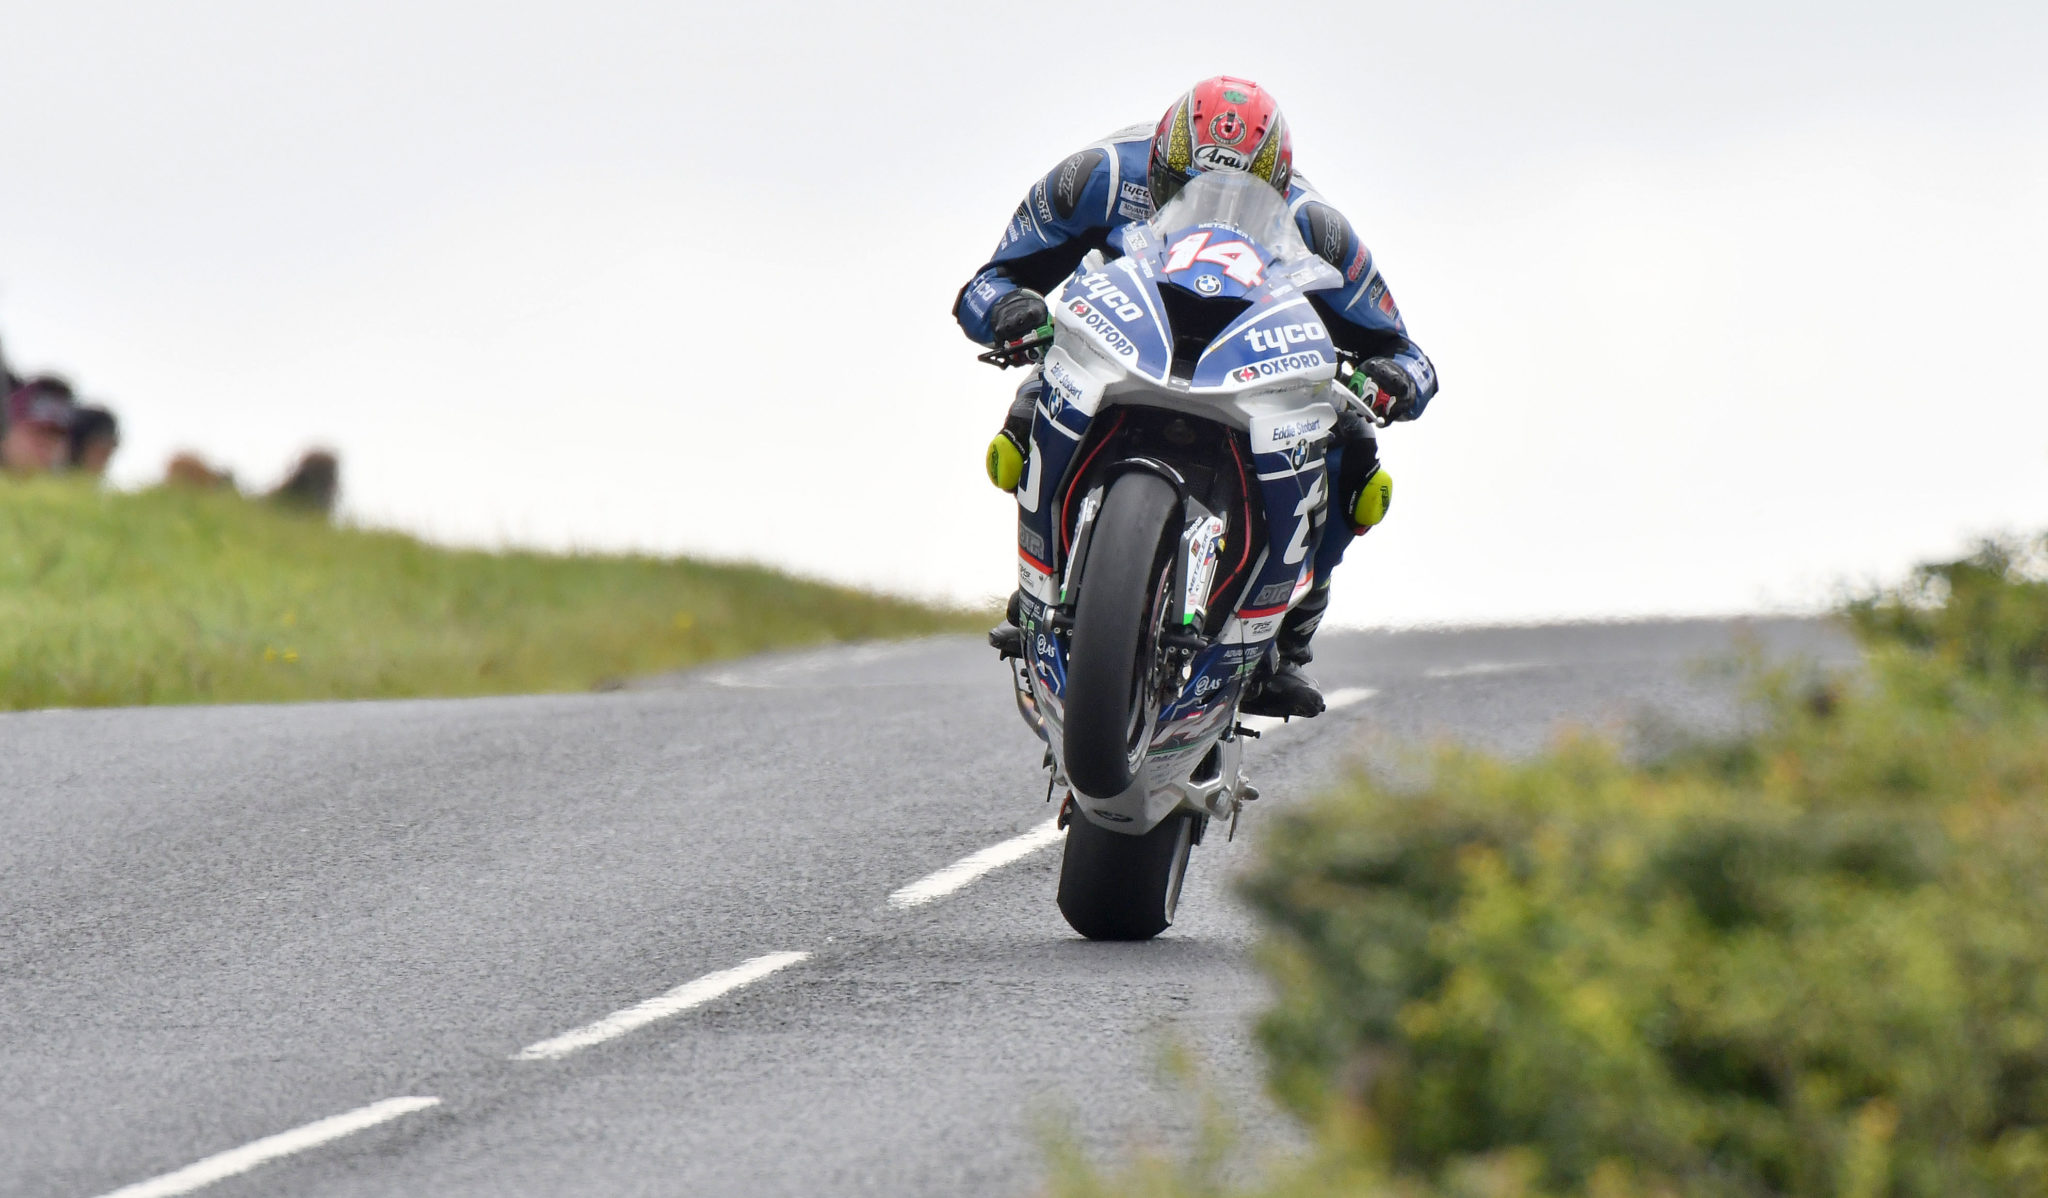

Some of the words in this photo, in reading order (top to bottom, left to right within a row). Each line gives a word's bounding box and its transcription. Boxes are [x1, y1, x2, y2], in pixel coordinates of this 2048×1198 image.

[1162, 231, 1265, 288] 14
[1081, 272, 1145, 322] tyco
[1085, 313, 1134, 357] OXFORD
[1244, 322, 1326, 354] tyco
[1260, 353, 1320, 376] OXFORD
[1272, 427, 1296, 441] Eddie
[1297, 418, 1321, 436] Stobart
